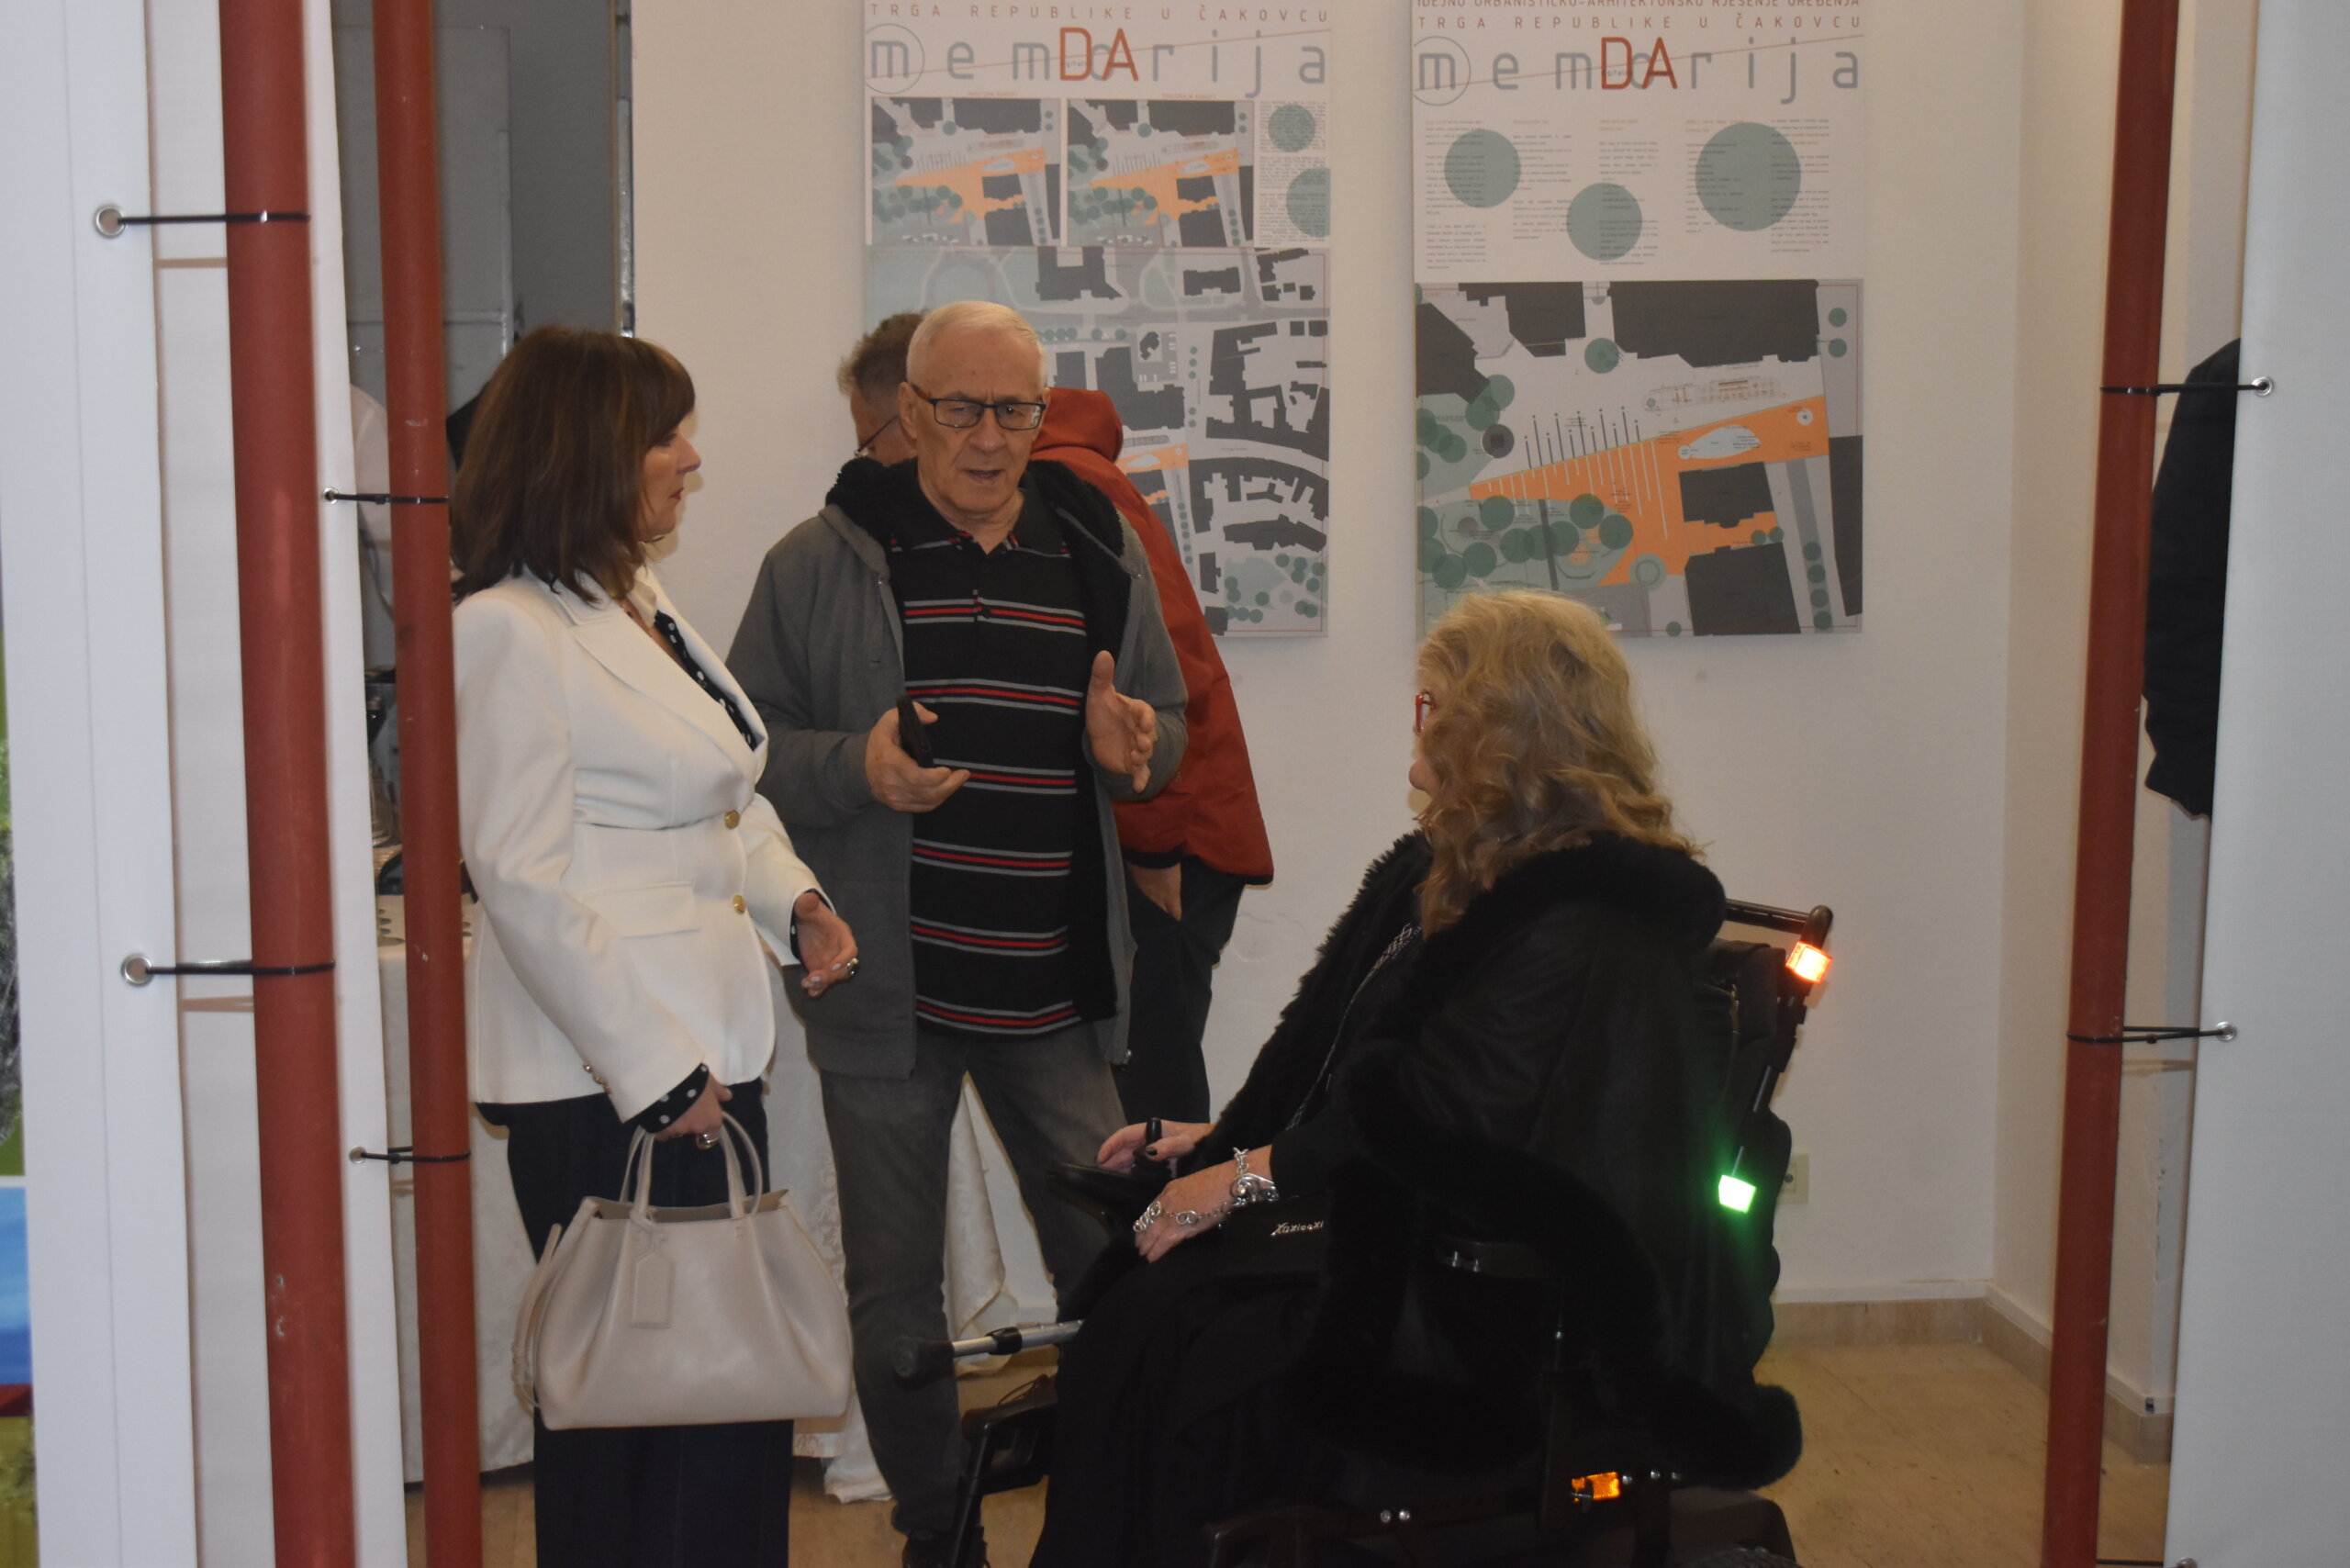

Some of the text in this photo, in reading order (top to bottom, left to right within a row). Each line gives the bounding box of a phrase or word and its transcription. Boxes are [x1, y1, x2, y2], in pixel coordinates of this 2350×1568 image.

[871, 4, 1327, 22] TRGA REPUBLIKE U ČAKOVCU
[1417, 12, 1860, 29] TRGA REPUBLIKE U ČAKOVCU
